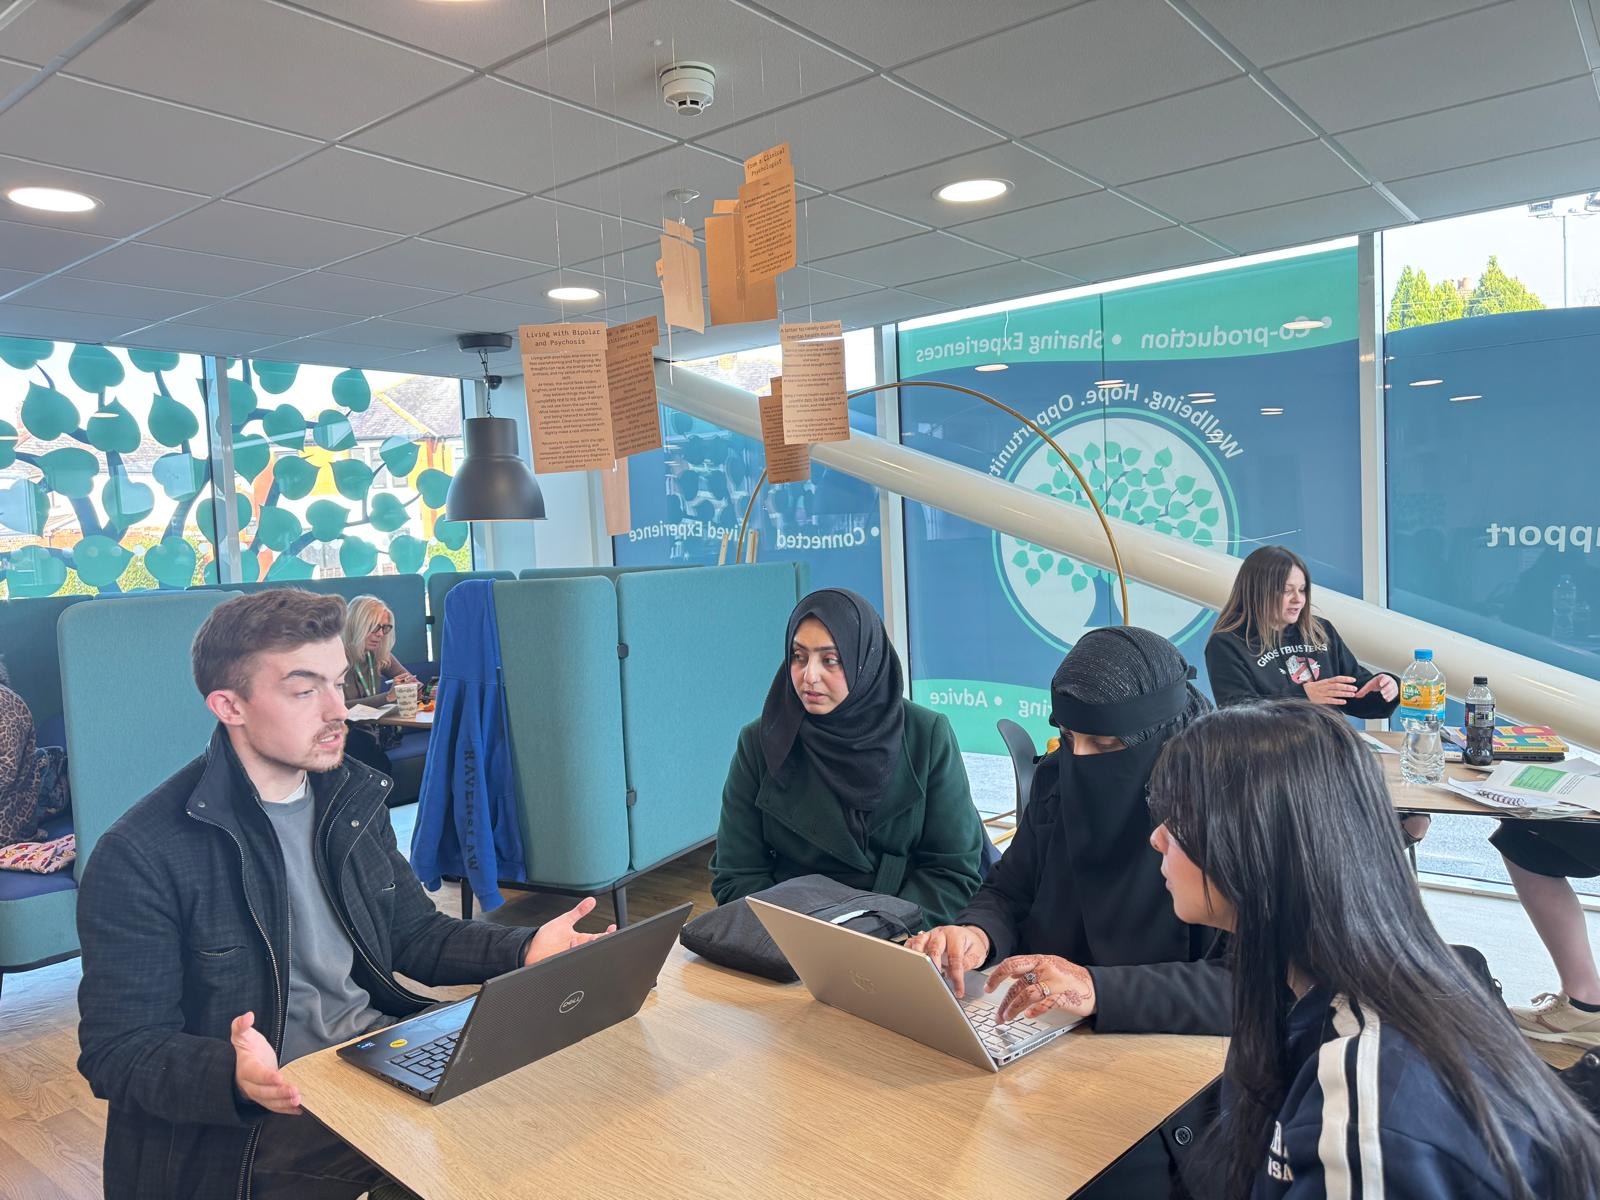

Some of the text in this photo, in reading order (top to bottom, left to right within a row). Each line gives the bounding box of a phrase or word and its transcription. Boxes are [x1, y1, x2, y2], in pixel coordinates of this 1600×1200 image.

[526, 331, 551, 339] Living
[572, 328, 601, 337] Bipolar
[550, 338, 586, 346] Psychosis
[1257, 643, 1328, 667] GHOSTBUSTERS
